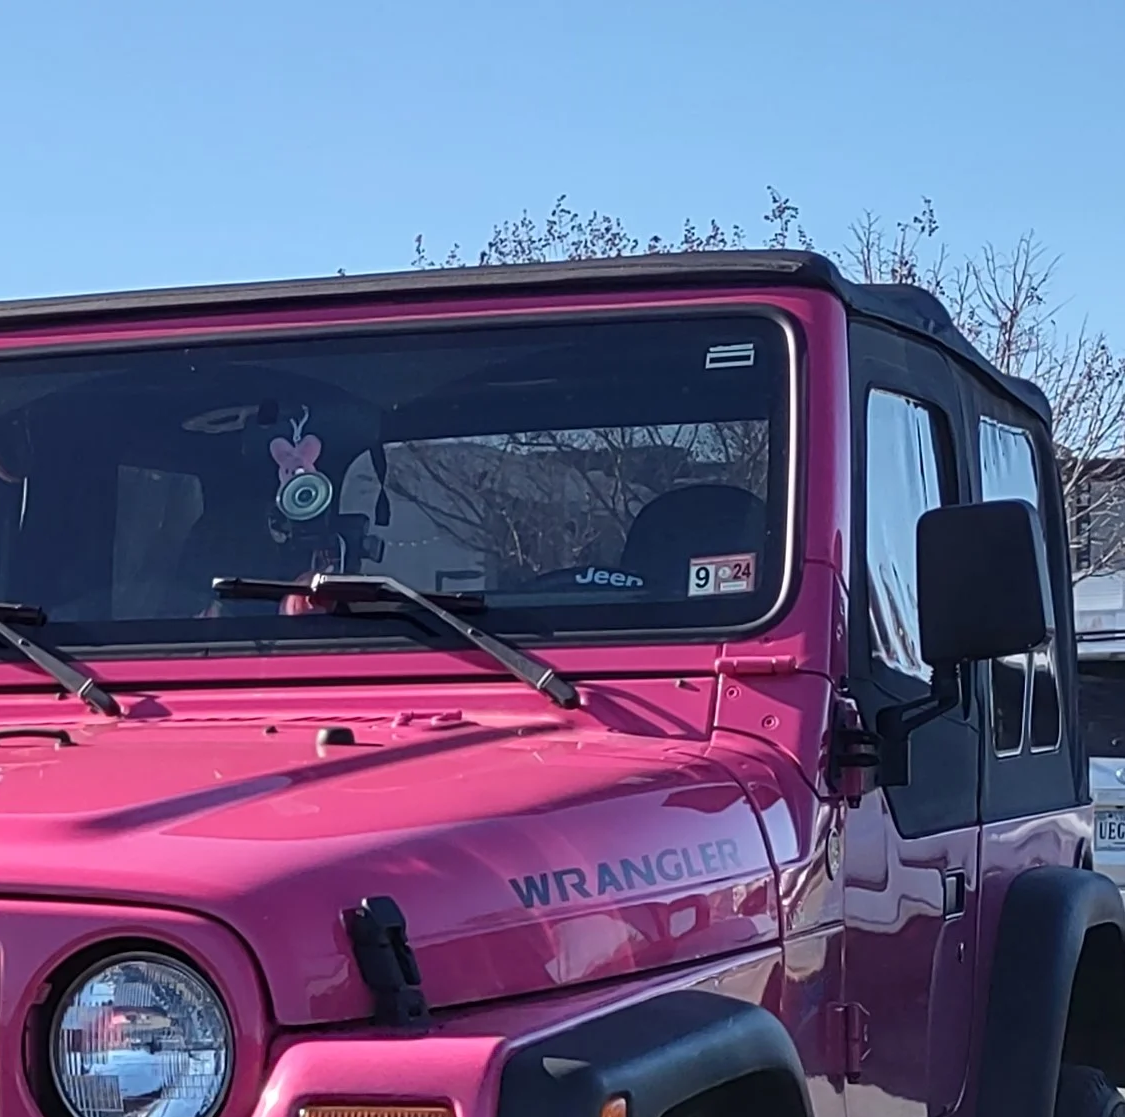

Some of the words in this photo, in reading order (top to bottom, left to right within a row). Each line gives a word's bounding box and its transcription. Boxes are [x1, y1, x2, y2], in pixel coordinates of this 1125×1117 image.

[695, 566, 710, 589] 9
[733, 562, 752, 580] 24
[508, 838, 742, 909] WRANGLER
